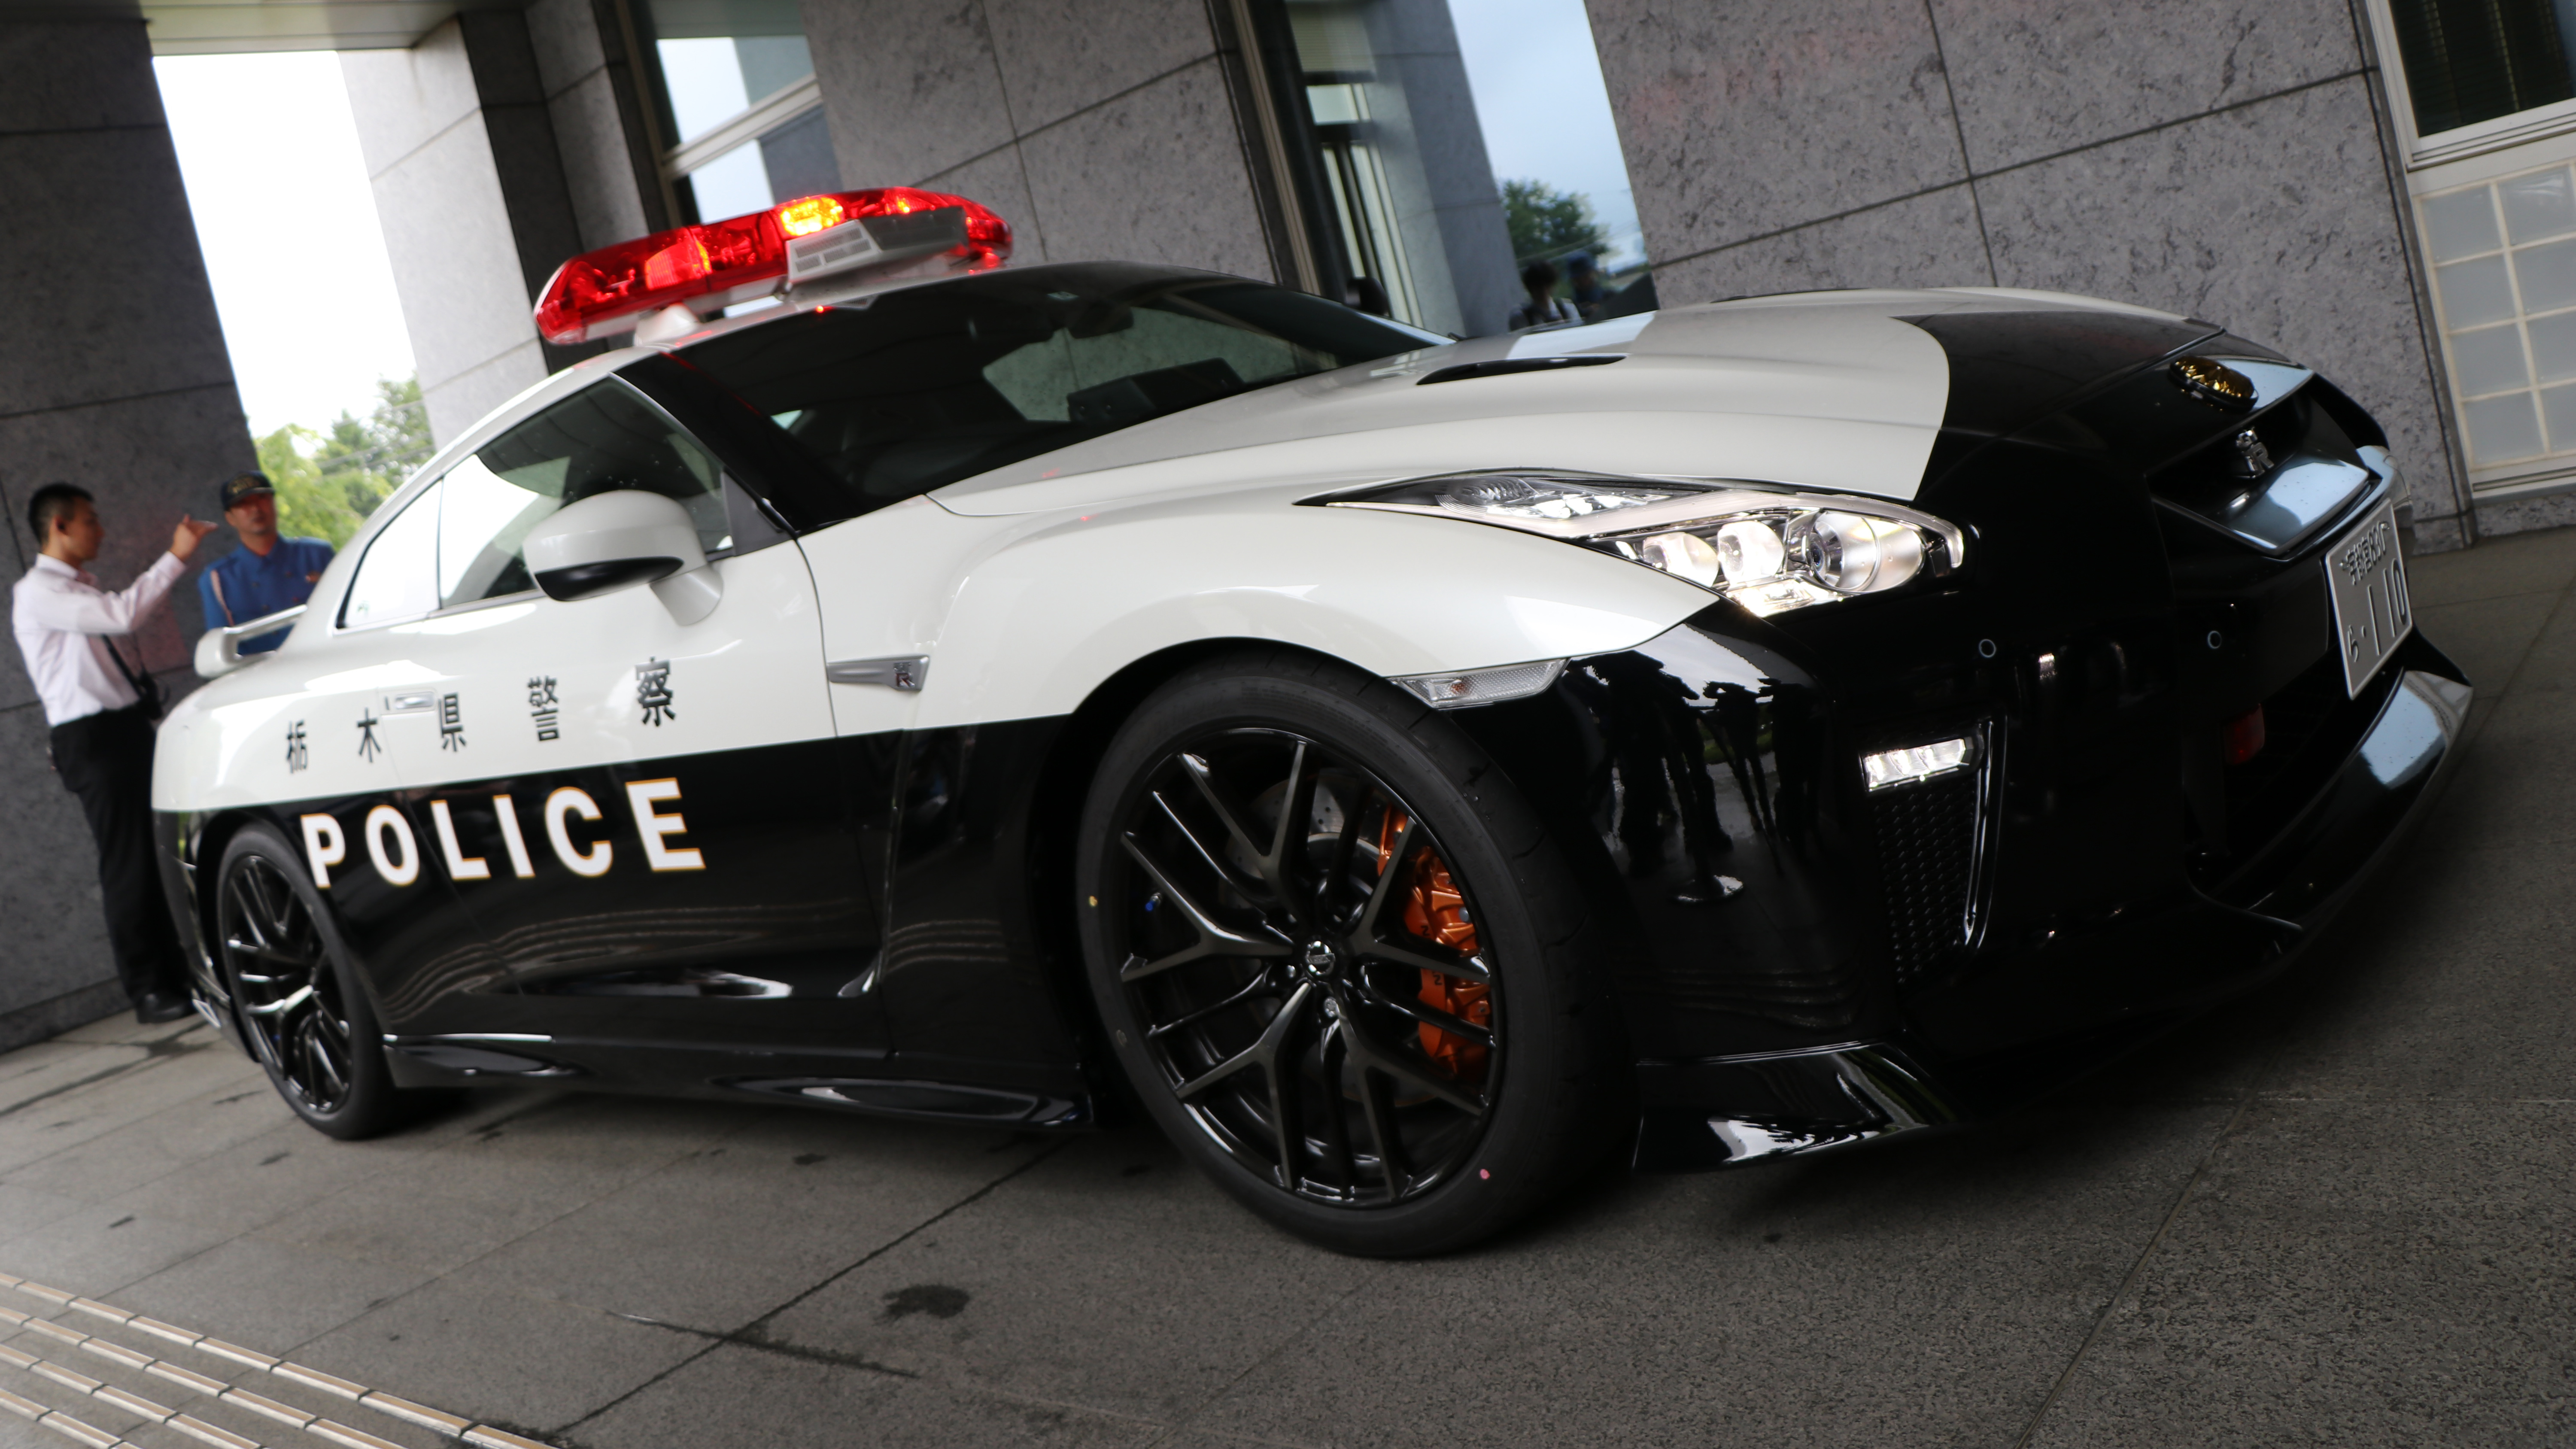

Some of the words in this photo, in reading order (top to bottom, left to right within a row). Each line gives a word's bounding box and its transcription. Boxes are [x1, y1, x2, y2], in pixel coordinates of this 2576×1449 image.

[2367, 520, 2387, 566] 830
[286, 656, 677, 774] 栃木県警察
[300, 777, 706, 889] POLICE
